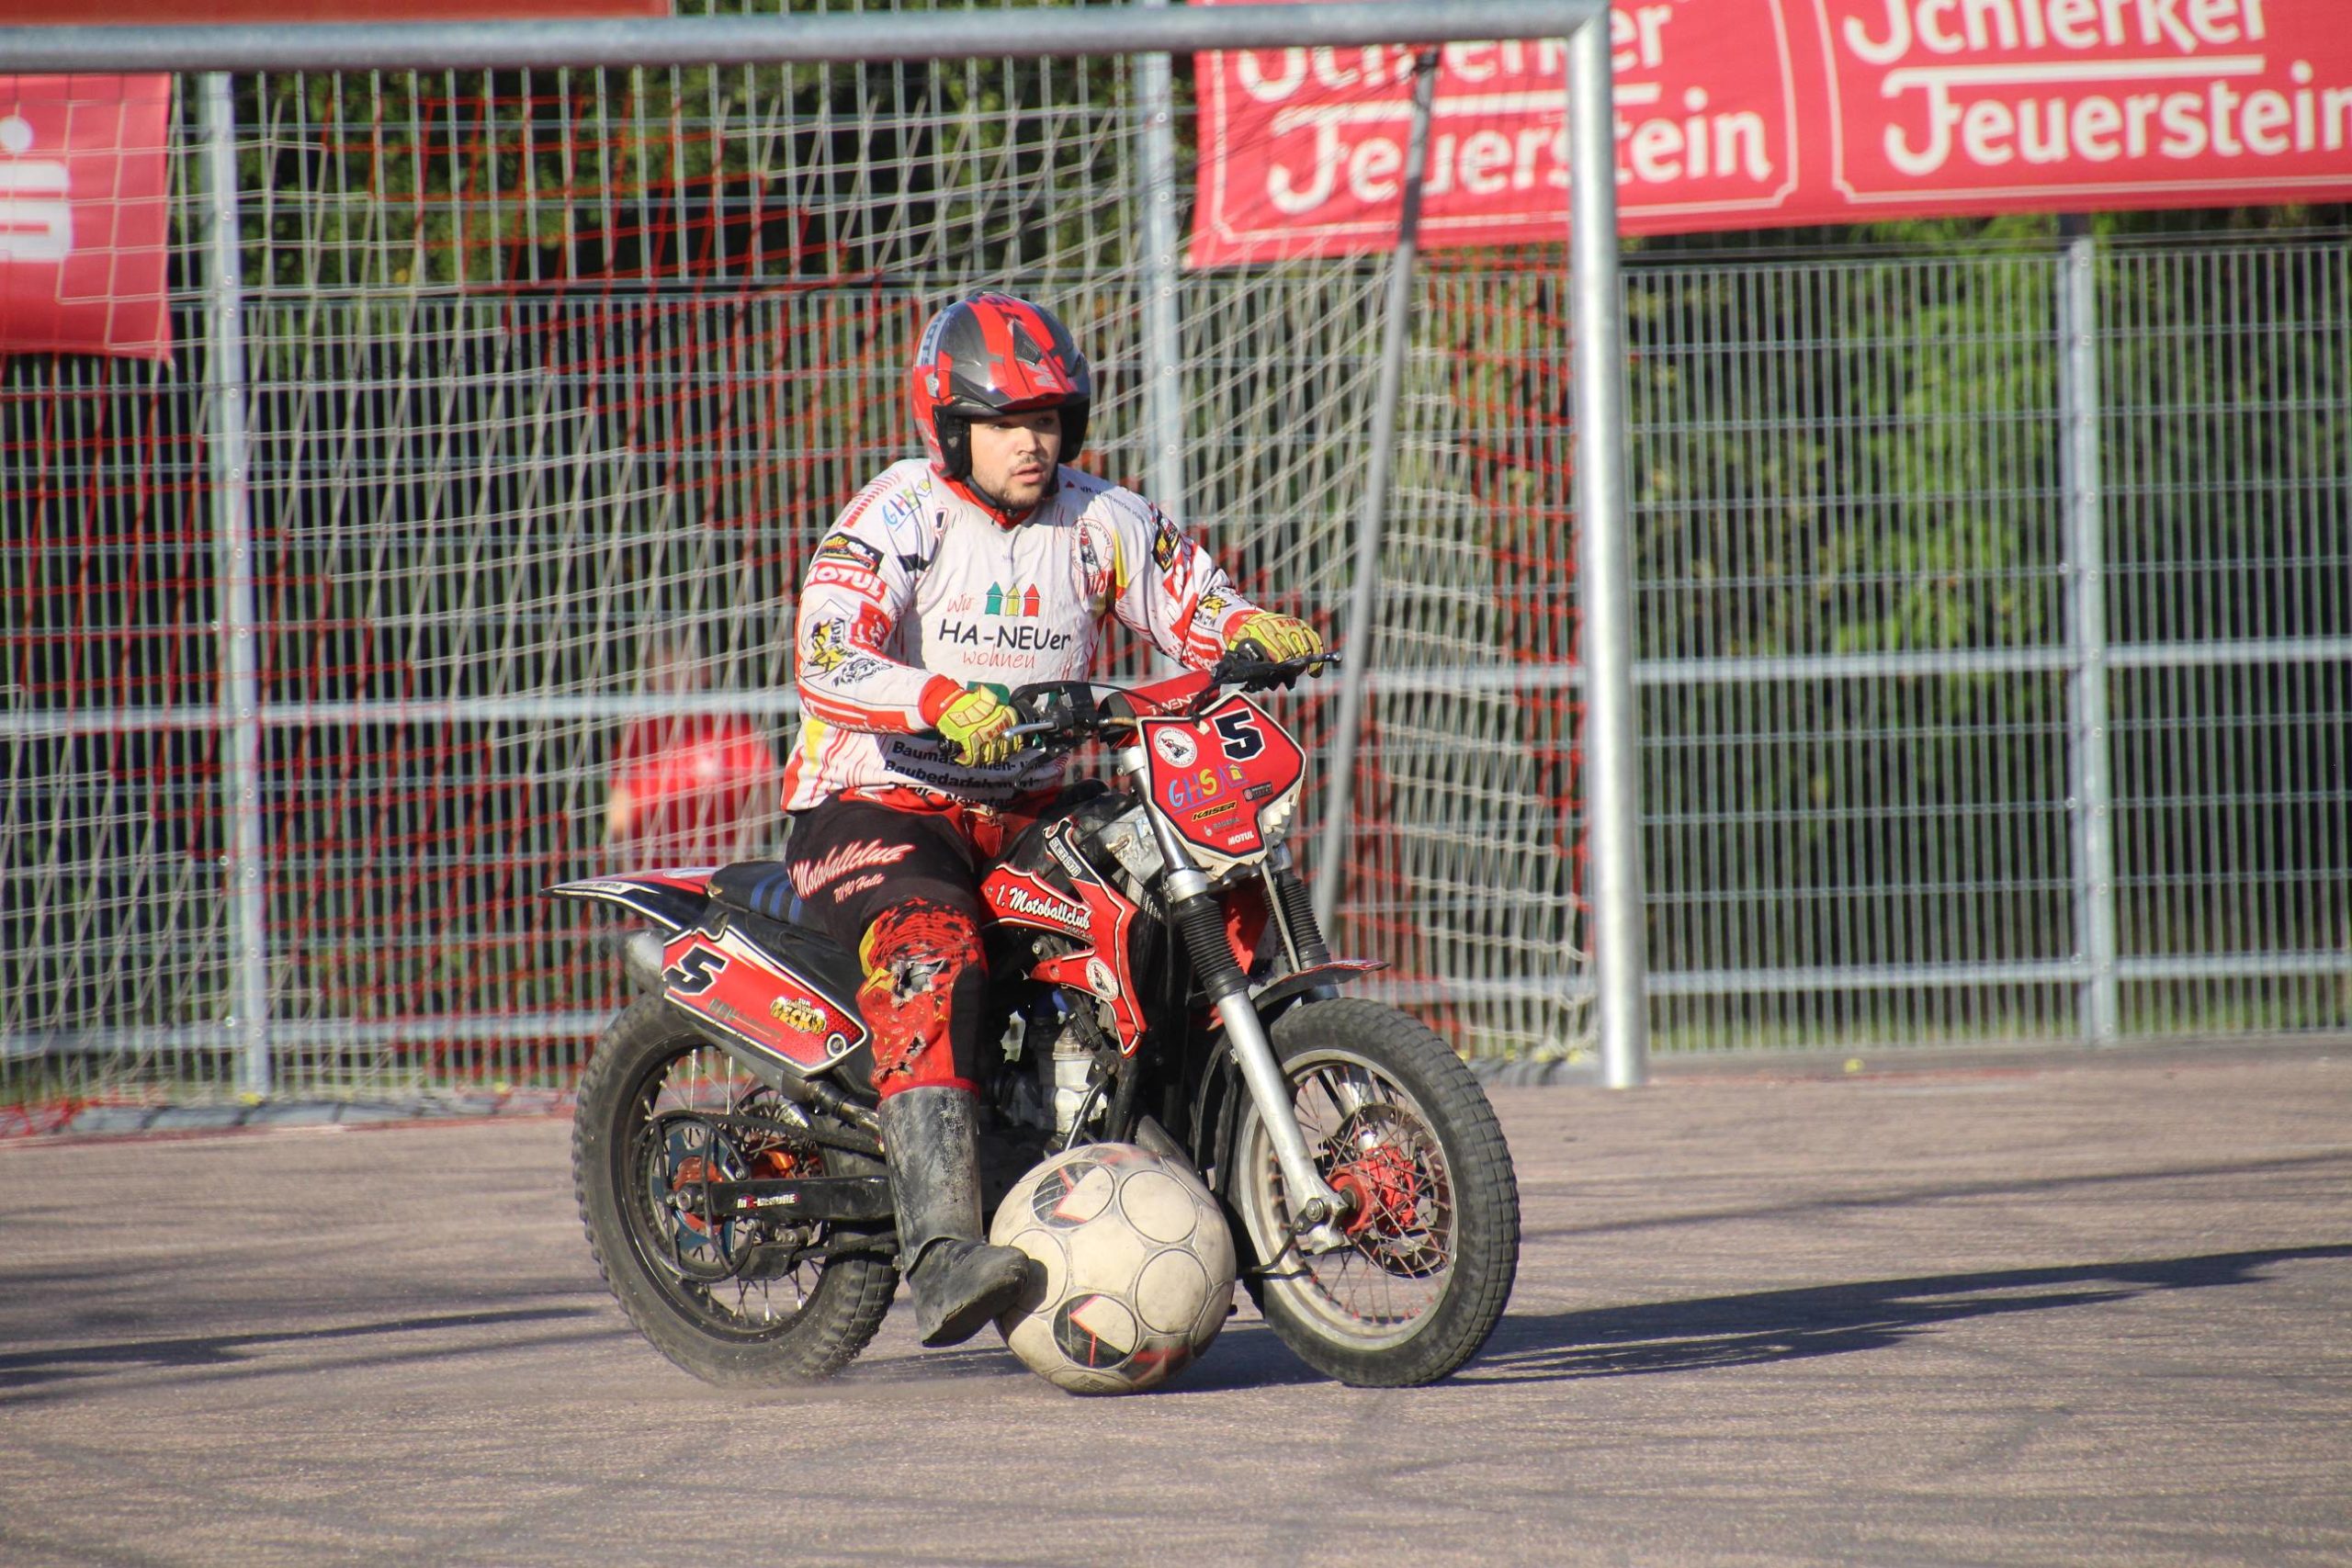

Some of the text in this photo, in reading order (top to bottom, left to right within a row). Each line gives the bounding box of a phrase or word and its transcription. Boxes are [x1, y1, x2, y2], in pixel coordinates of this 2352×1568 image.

[946, 592, 976, 613] Wir
[938, 618, 1071, 650] HA-NEUer
[963, 644, 1035, 669] wohnen
[1212, 707, 1266, 763] 5
[1193, 802, 1237, 821] KAISER
[1227, 830, 1254, 846] MOTUL
[1049, 837, 1082, 876] SINCE 1970
[996, 884, 1092, 930] 1. Motoballclub
[662, 942, 730, 996] 5
